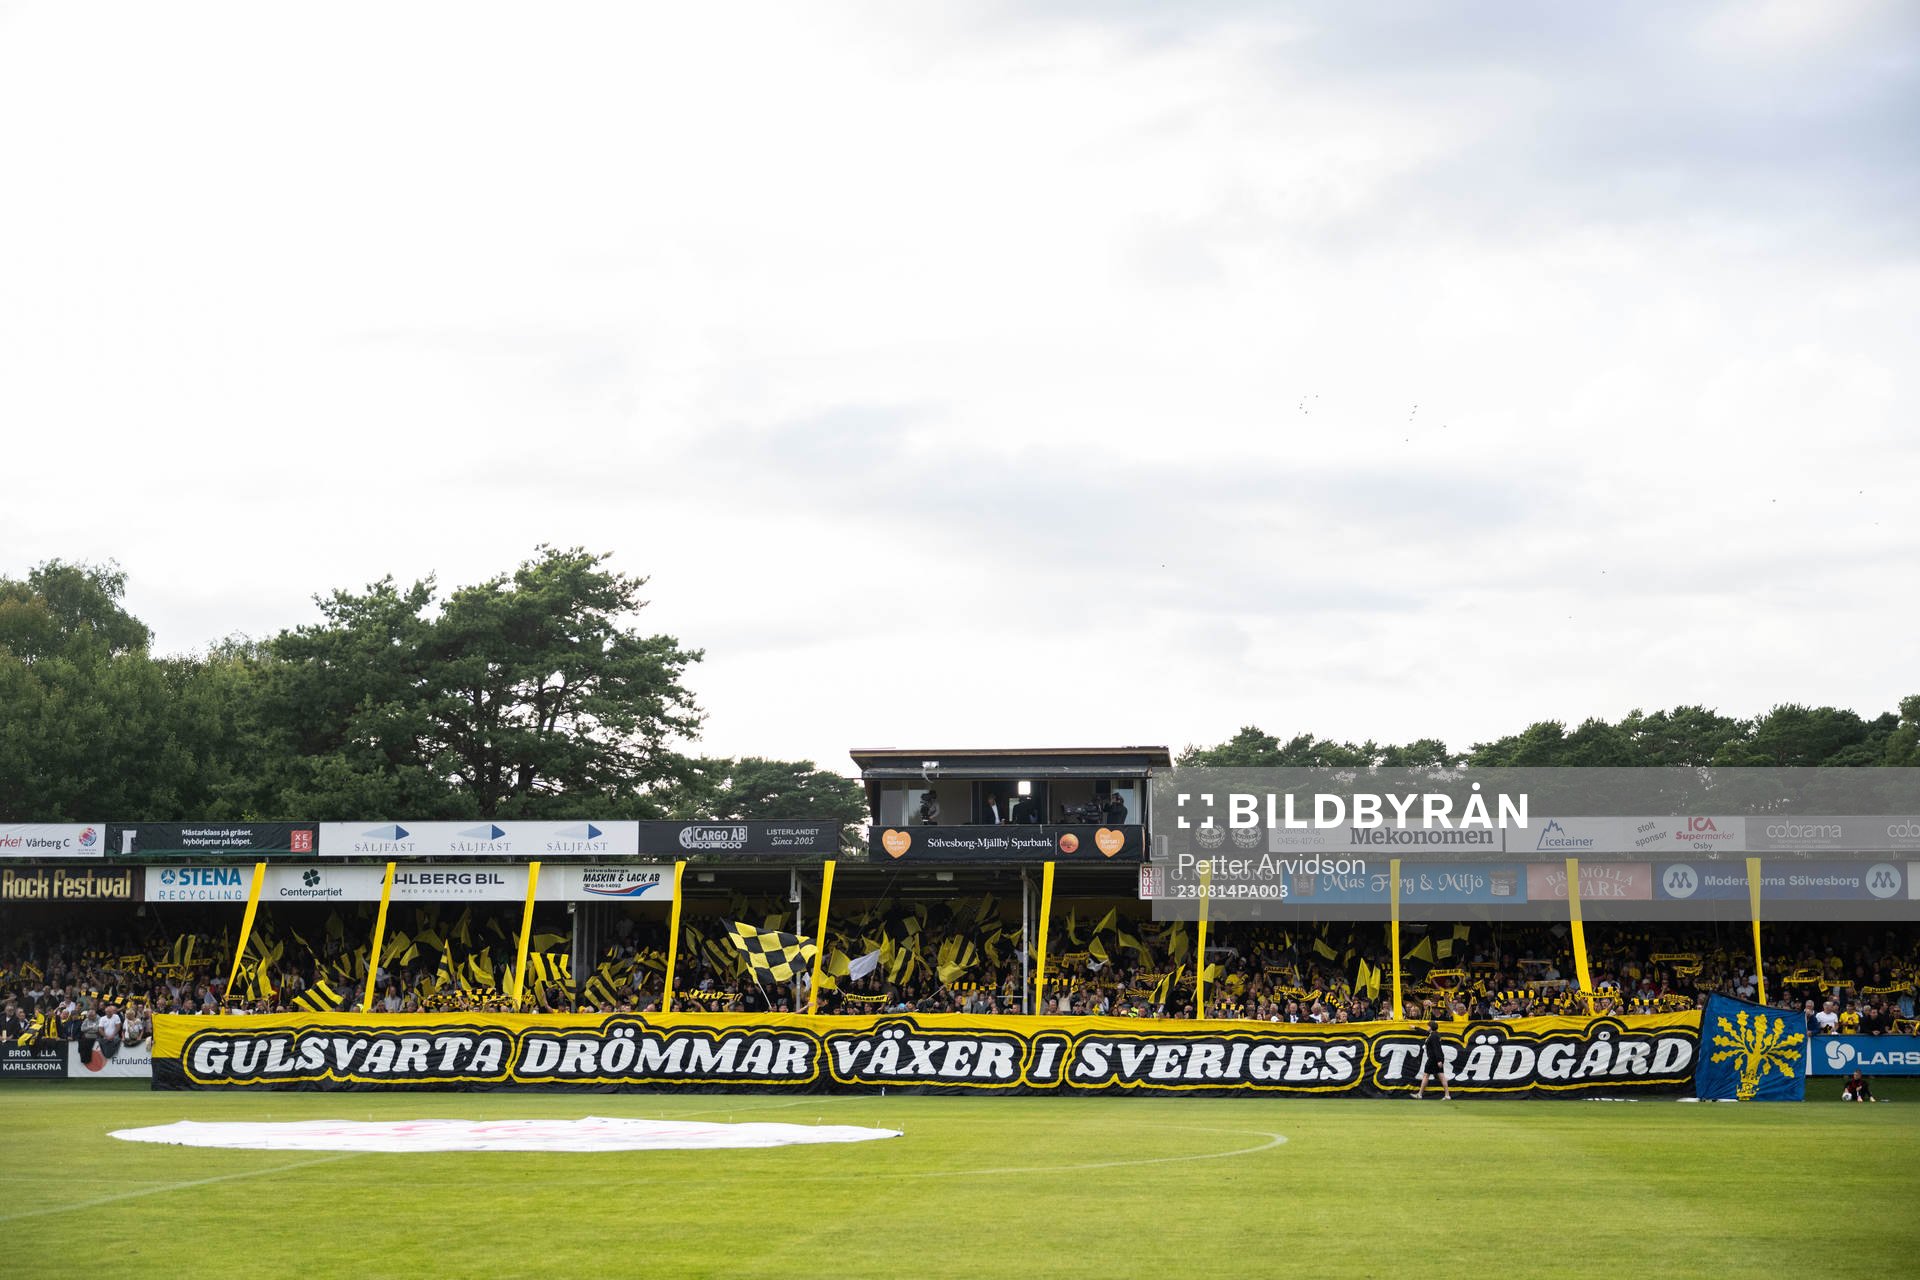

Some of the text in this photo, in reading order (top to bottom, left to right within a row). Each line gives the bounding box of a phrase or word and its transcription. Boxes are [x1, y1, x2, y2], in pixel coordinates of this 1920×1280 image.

[1637, 821, 1656, 834] stolt
[1687, 816, 1717, 832] ICA
[1766, 820, 1842, 838] colorama
[730, 828, 746, 841] AB
[766, 828, 820, 836] LISTERLANDET
[1350, 827, 1494, 845] Mekonomen
[1675, 831, 1735, 842] Supermarket
[63, 838, 70, 847] C
[771, 836, 815, 846] Since 2005
[1011, 837, 1053, 849] Sparbank
[1545, 836, 1594, 847] icetainer
[1635, 830, 1668, 848] sponsor
[354, 842, 415, 853] SÄLJFAST
[450, 841, 512, 853] SÄLJFAST
[547, 841, 608, 853] SÄLJFAST
[1693, 842, 1713, 850] Osby
[179, 868, 242, 886] STENA
[475, 873, 505, 884] BIL
[583, 873, 660, 882] MASKIN & LACK AB
[1545, 866, 1633, 887] BRMÖLLA
[1704, 876, 1785, 886] Moderaerna
[1789, 875, 1860, 888] Sölvesborg
[2, 868, 132, 900] Rock Festival
[1323, 873, 1484, 895] Mias Frg & Miljö
[1554, 880, 1626, 898] CARK
[159, 890, 243, 900] RECYCLING
[280, 887, 343, 898] Centerpartiet
[193, 1037, 504, 1074] GULSVARTA
[519, 1028, 809, 1074] DRÖMMAR
[833, 1029, 1015, 1079] VÄXER
[1033, 1043, 1060, 1077] I
[1075, 1043, 1357, 1081] SVERIGES
[1857, 1051, 1920, 1065] LARS
